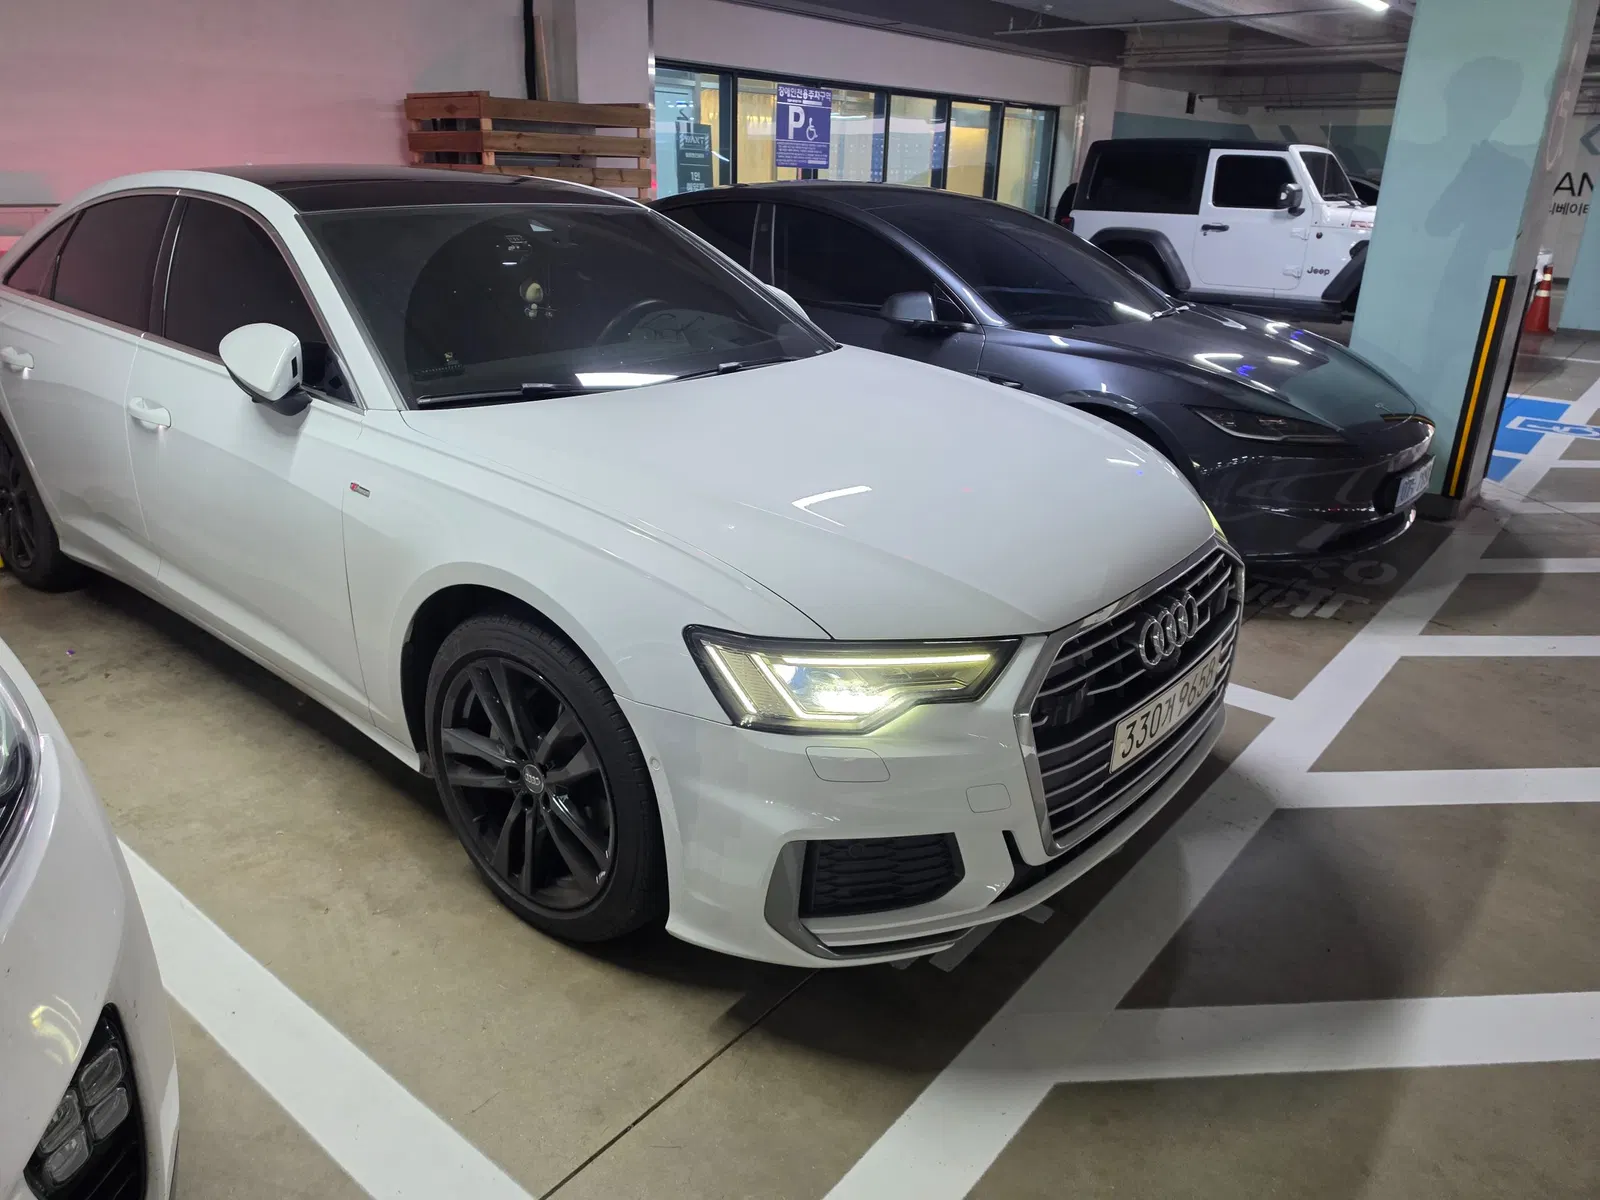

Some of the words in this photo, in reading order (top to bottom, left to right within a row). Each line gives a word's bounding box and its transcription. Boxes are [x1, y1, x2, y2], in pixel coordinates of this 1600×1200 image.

[778, 86, 832, 102] 장애인전용주차구역
[788, 105, 806, 140] P
[1306, 266, 1331, 276] Jeep
[1178, 656, 1216, 717] 9658
